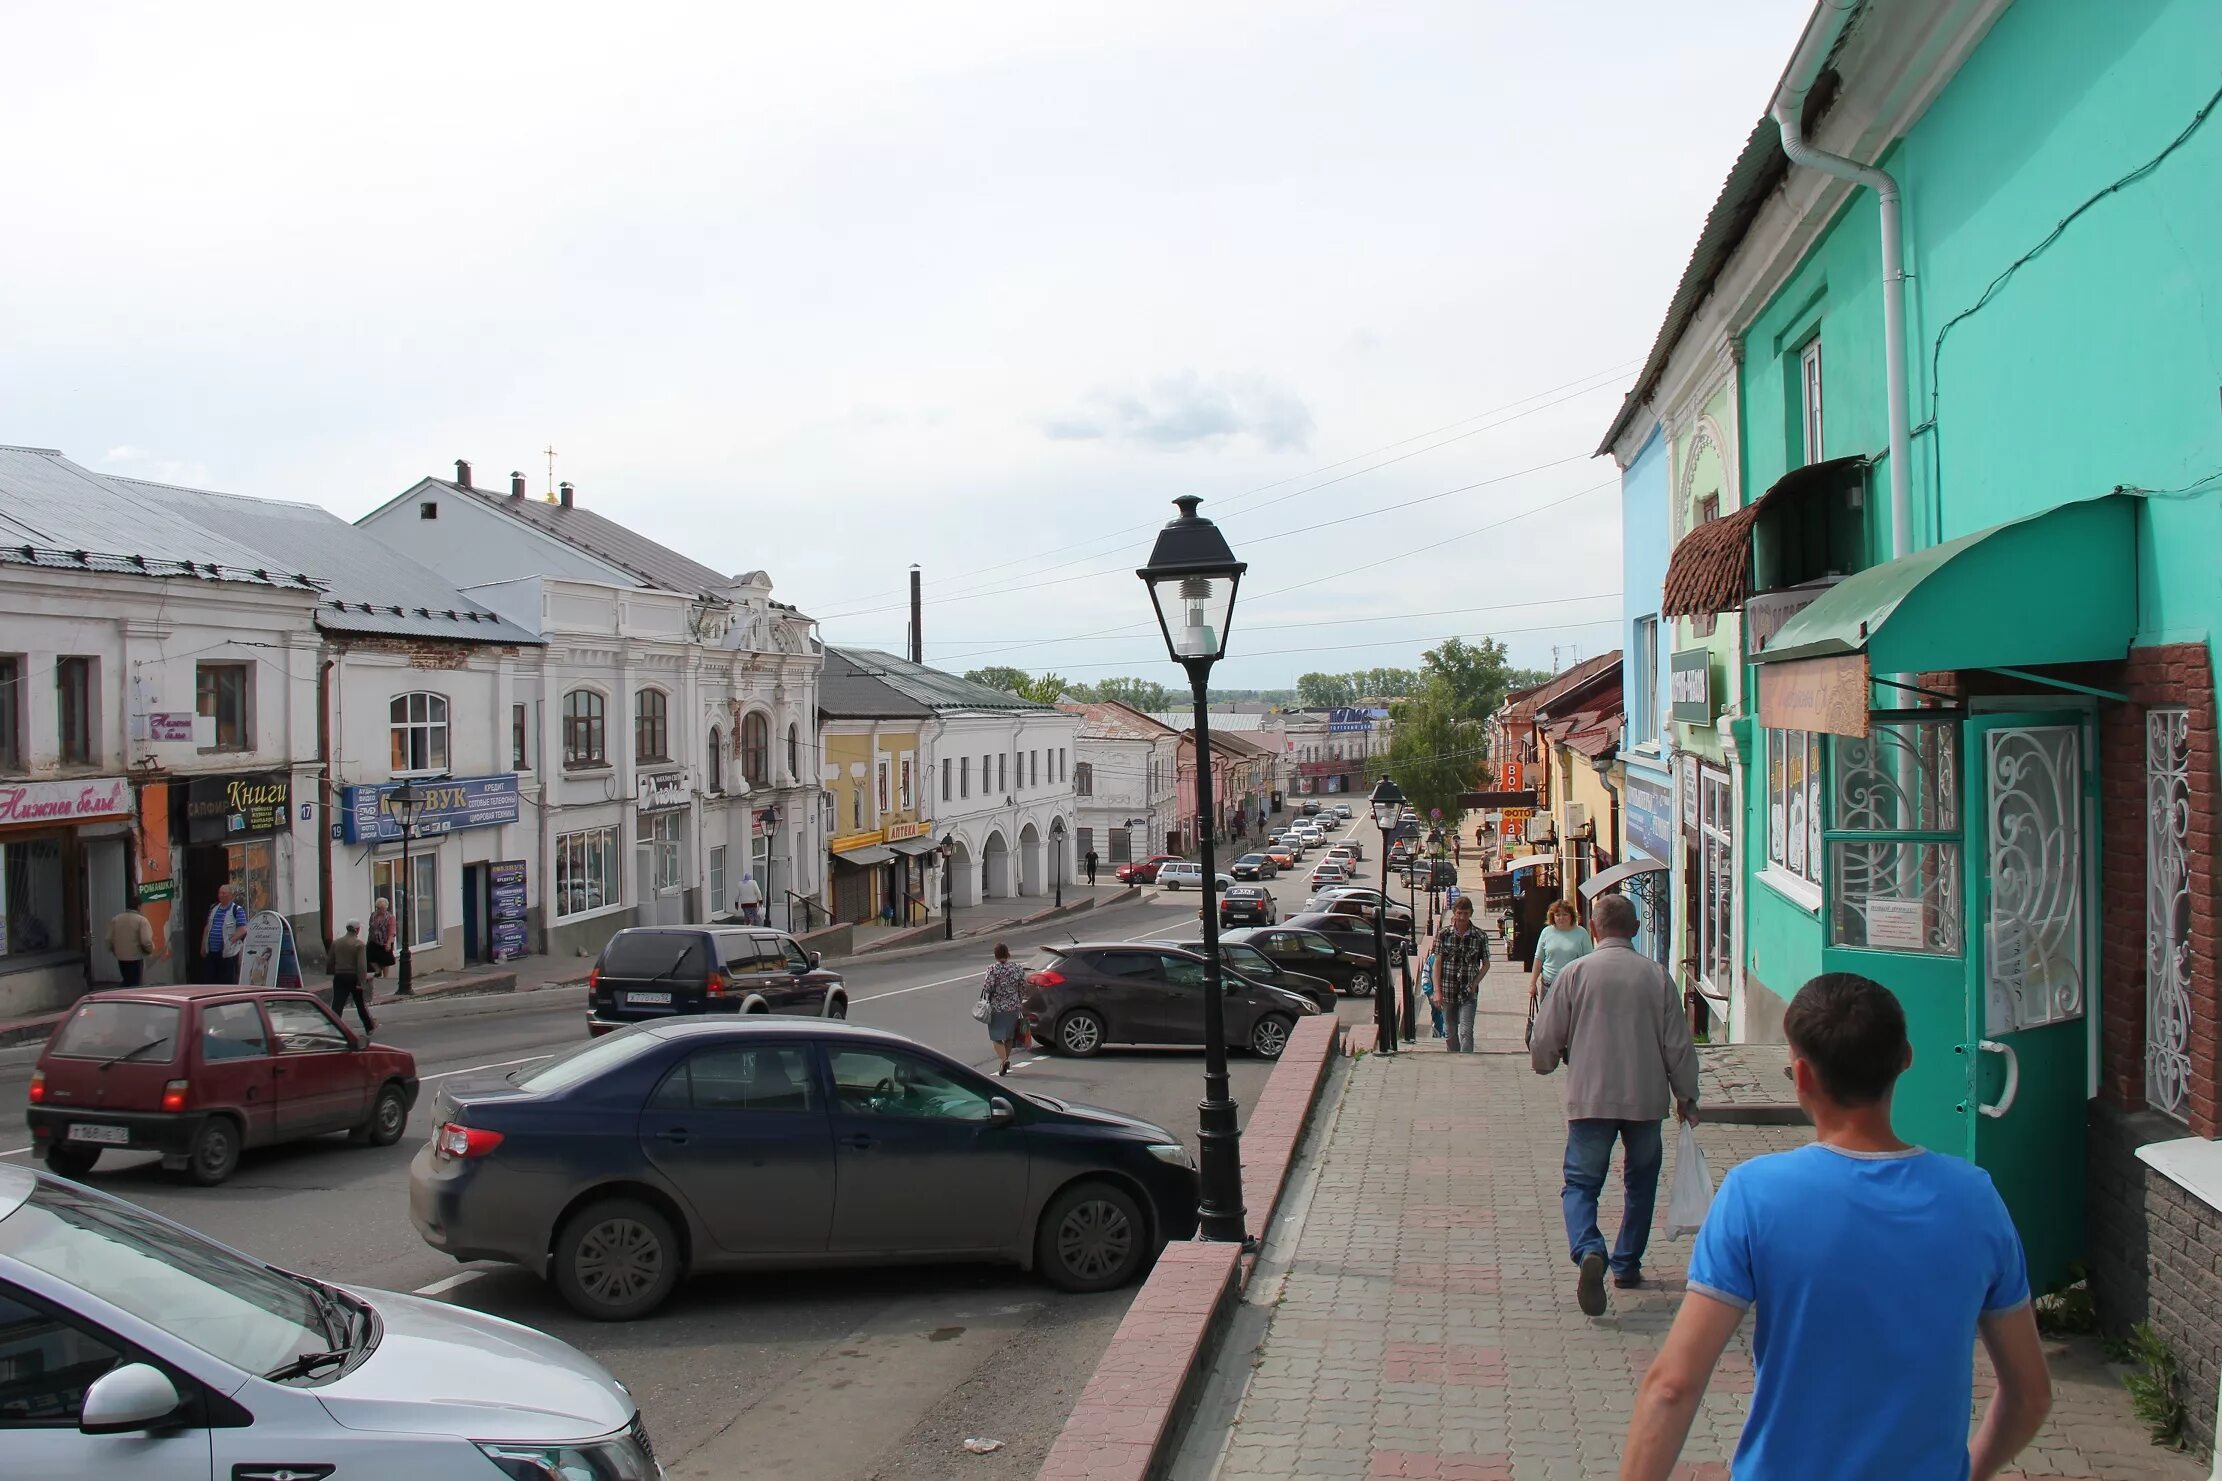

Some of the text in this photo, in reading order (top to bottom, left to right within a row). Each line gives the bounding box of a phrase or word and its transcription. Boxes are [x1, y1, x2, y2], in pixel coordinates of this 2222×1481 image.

[484, 782, 505, 792] КРЕДИТ
[0, 786, 115, 820] Нижнее белье
[227, 780, 287, 812] Книги
[468, 795, 516, 809] СОТОВЫЕ ТЕЛЕФОНЫ
[302, 806, 311, 819] 17
[469, 809, 516, 823] ЦИФРОВАЯ ТЕХНИКА
[1504, 809, 1531, 818] ФОТО
[332, 825, 342, 838] 19
[891, 824, 916, 840] АПТЕКА
[138, 880, 174, 894] РОМАШКА
